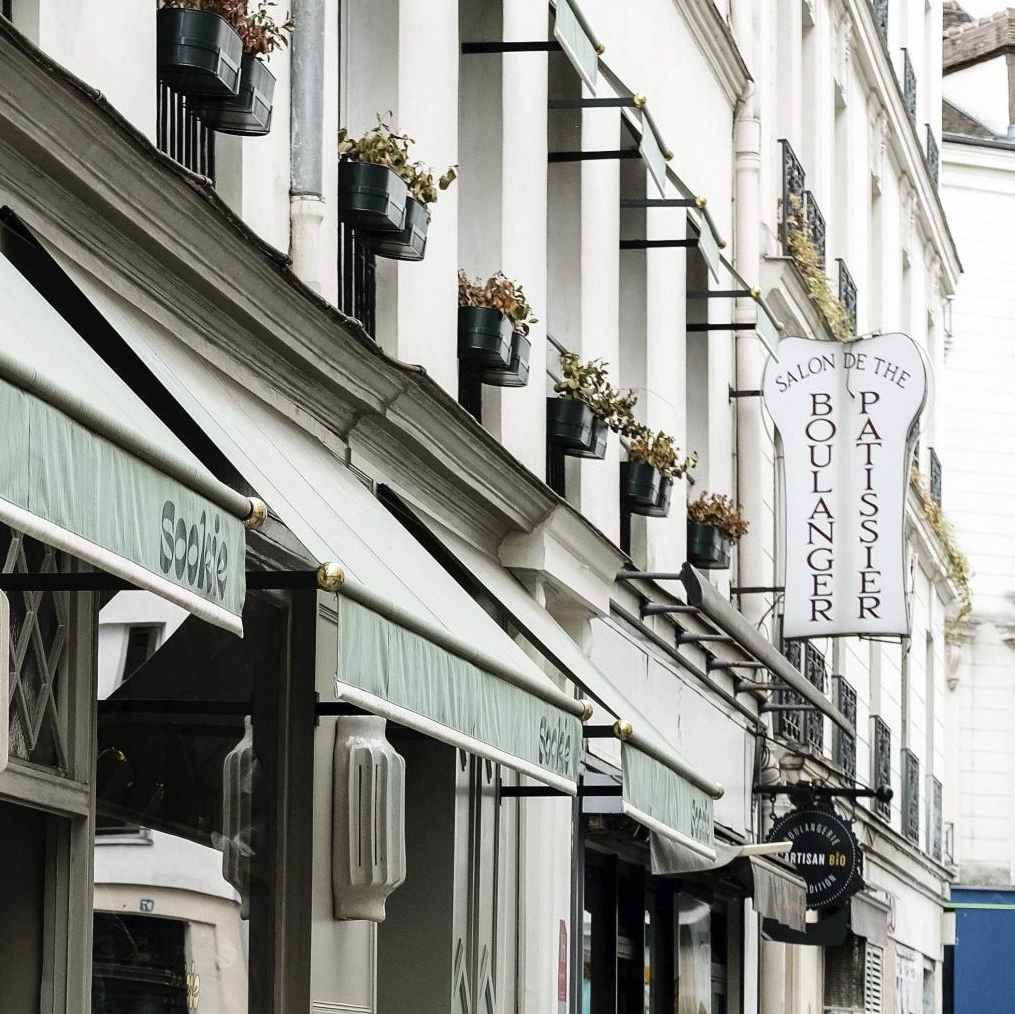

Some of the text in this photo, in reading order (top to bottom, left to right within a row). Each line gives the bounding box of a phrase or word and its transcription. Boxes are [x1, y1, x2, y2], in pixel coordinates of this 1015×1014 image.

[774, 352, 912, 393] SALON DE THE
[805, 392, 837, 622] BOULANGER
[856, 390, 882, 620] PATISSIER
[160, 500, 228, 600] Sookie
[784, 851, 825, 866] ARTISAN
[806, 874, 837, 895] DITION
